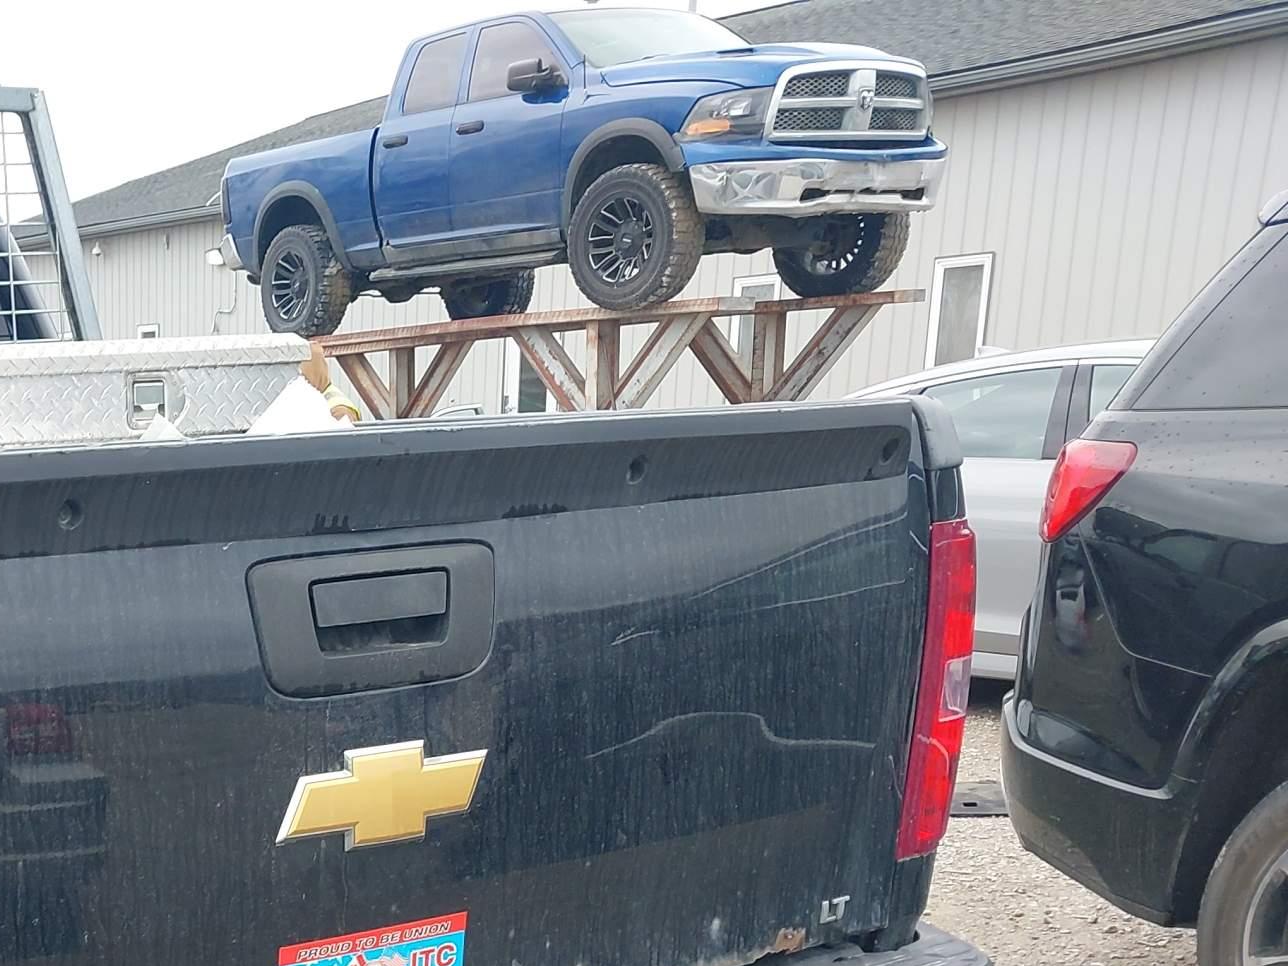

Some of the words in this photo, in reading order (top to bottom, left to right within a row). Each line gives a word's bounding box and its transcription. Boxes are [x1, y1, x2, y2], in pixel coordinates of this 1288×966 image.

[820, 895, 851, 925] LT
[297, 942, 352, 962] PROUD
[355, 937, 376, 951] TO
[379, 932, 400, 946] BE
[404, 921, 451, 940] UNION
